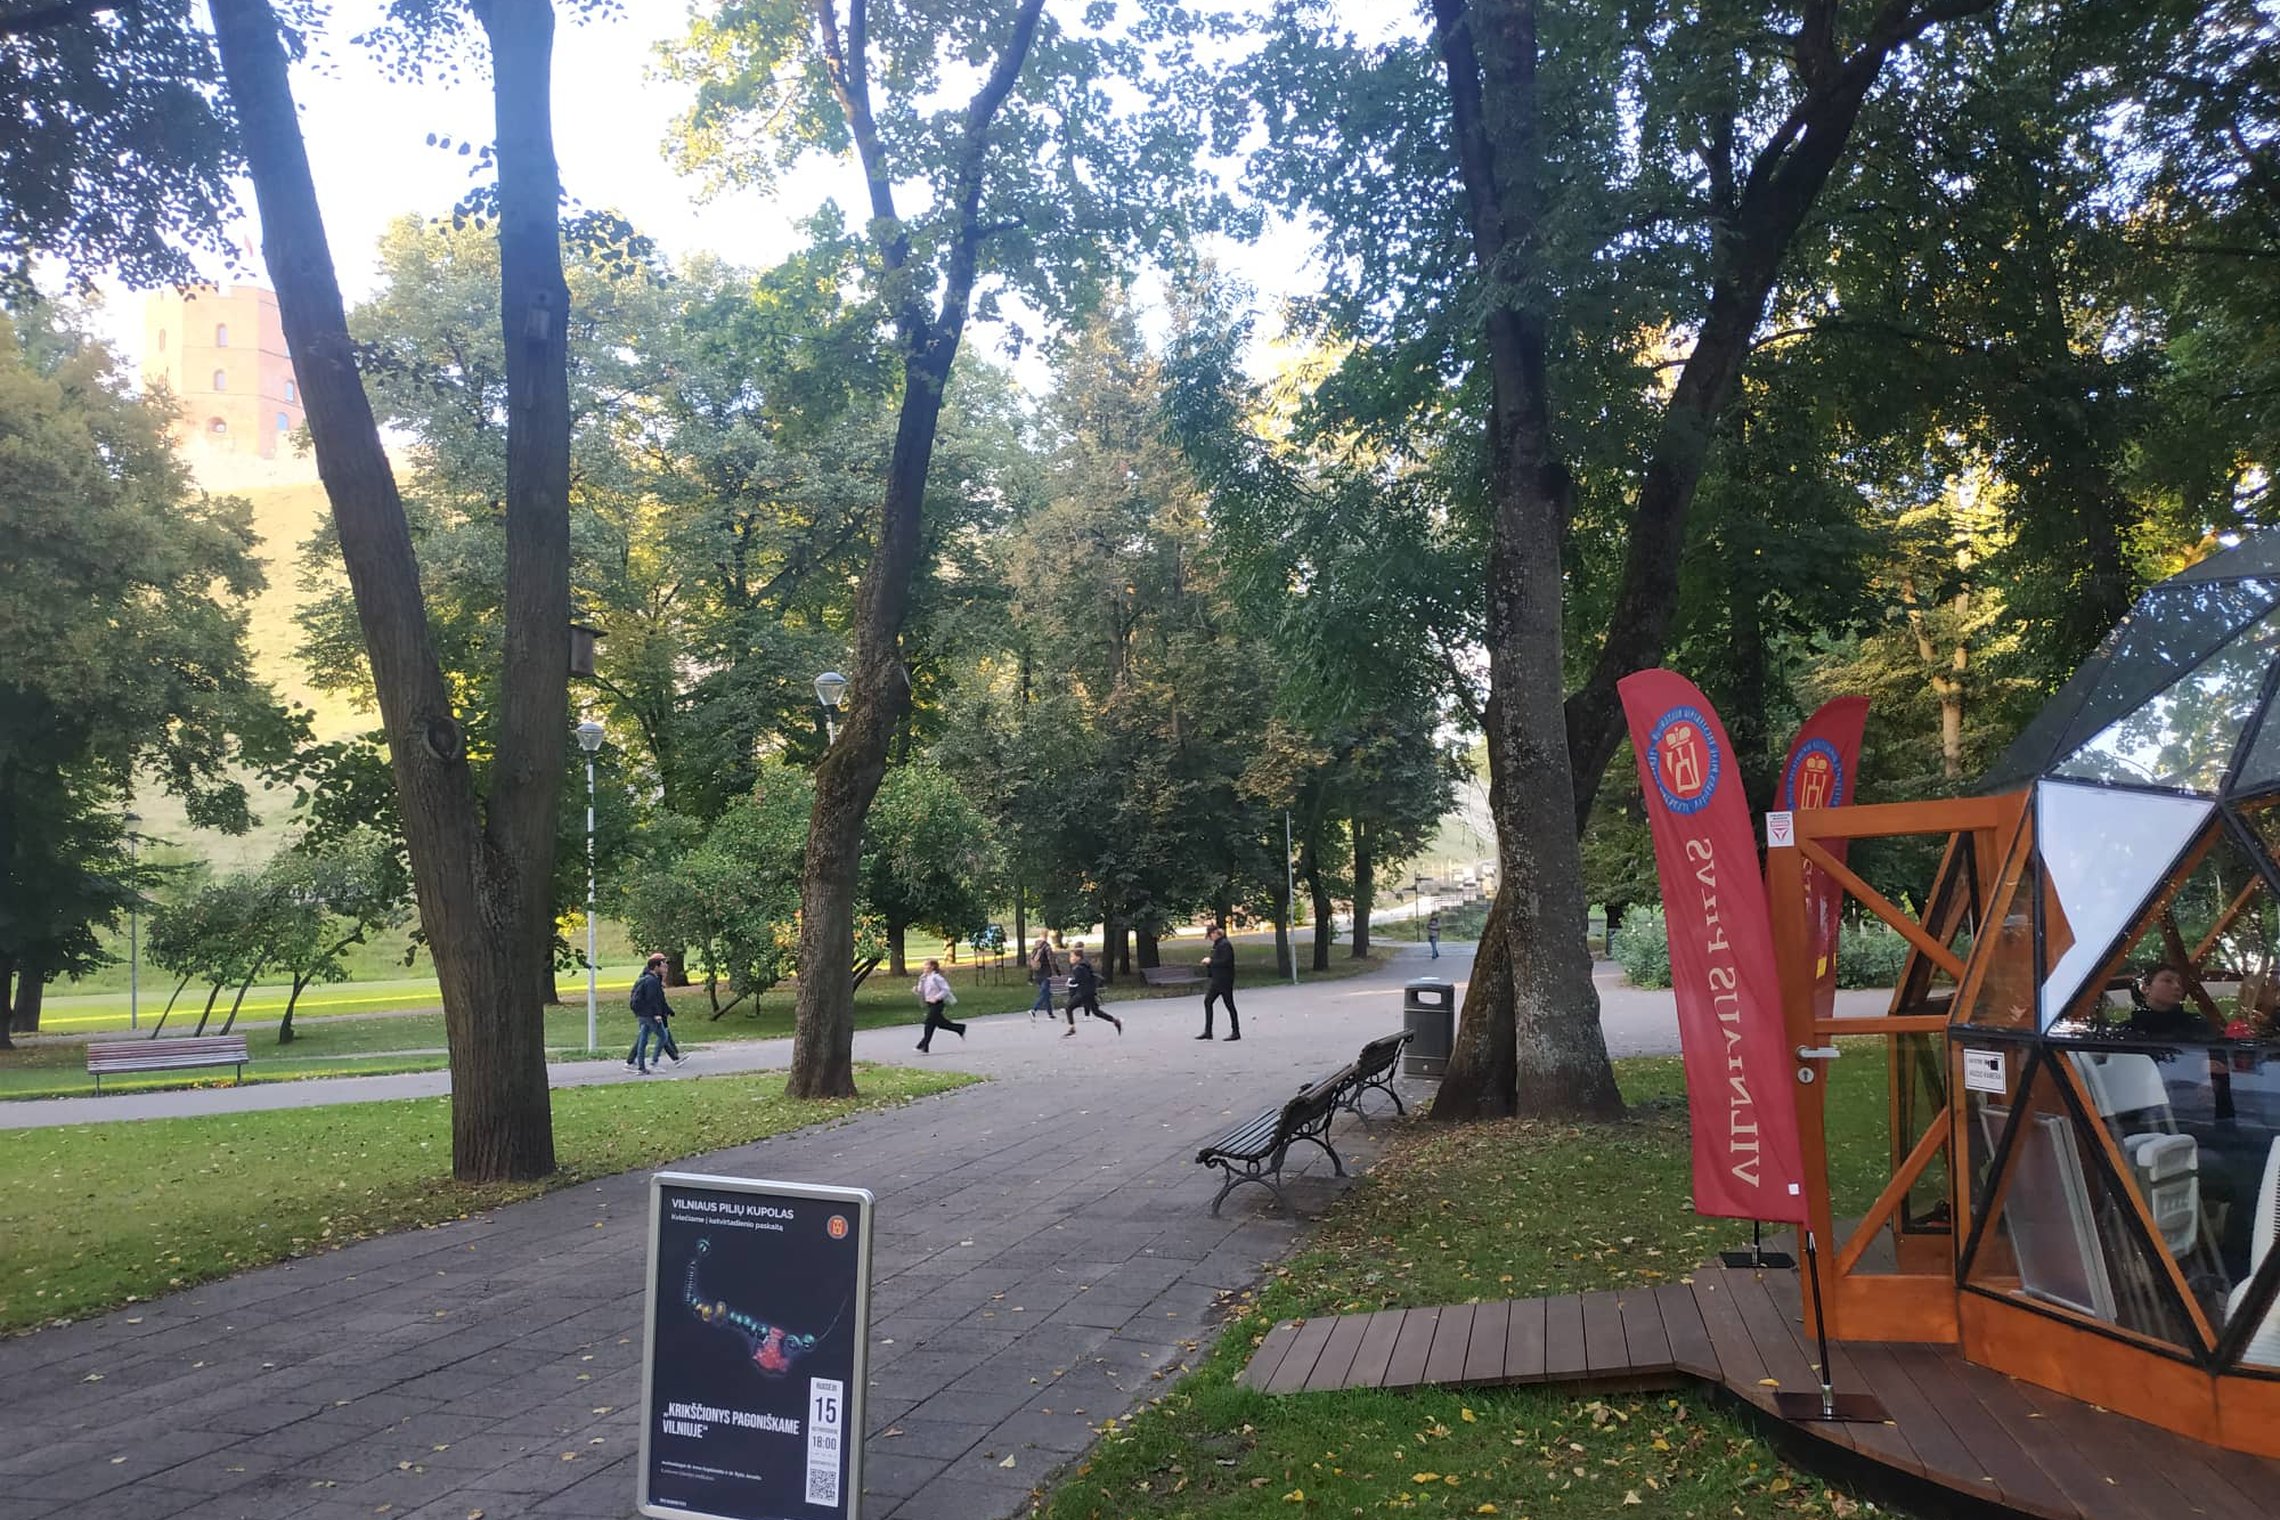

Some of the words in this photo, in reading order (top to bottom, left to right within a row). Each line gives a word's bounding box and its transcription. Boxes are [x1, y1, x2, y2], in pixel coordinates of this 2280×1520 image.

[671, 1198, 717, 1212] VILNIAUS
[719, 1202, 745, 1217] PILIŲ
[746, 1206, 795, 1220] KUPOLAS
[815, 1396, 837, 1424] 15
[732, 1411, 800, 1435] PAGONIŠKAME
[812, 1435, 837, 1450] 18:00
